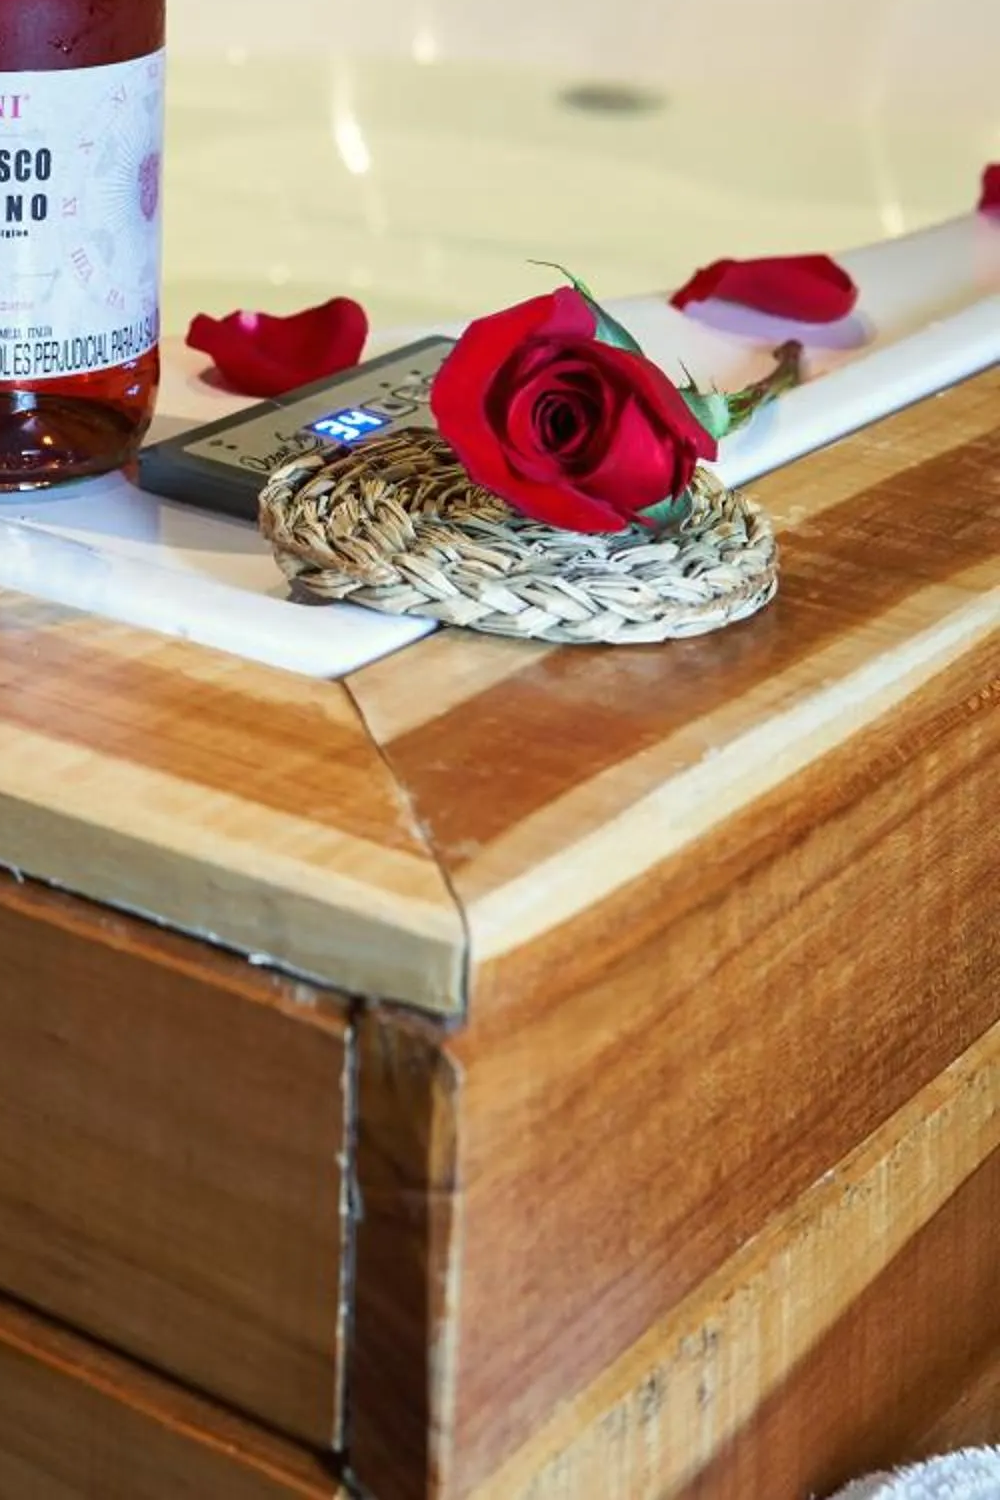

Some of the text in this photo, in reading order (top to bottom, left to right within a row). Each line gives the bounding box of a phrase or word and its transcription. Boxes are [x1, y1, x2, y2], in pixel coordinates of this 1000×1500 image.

[14, 342, 31, 376] ES
[35, 334, 109, 373] PERJUDICIAL
[111, 324, 133, 361] PARA
[314, 411, 384, 441] 34
